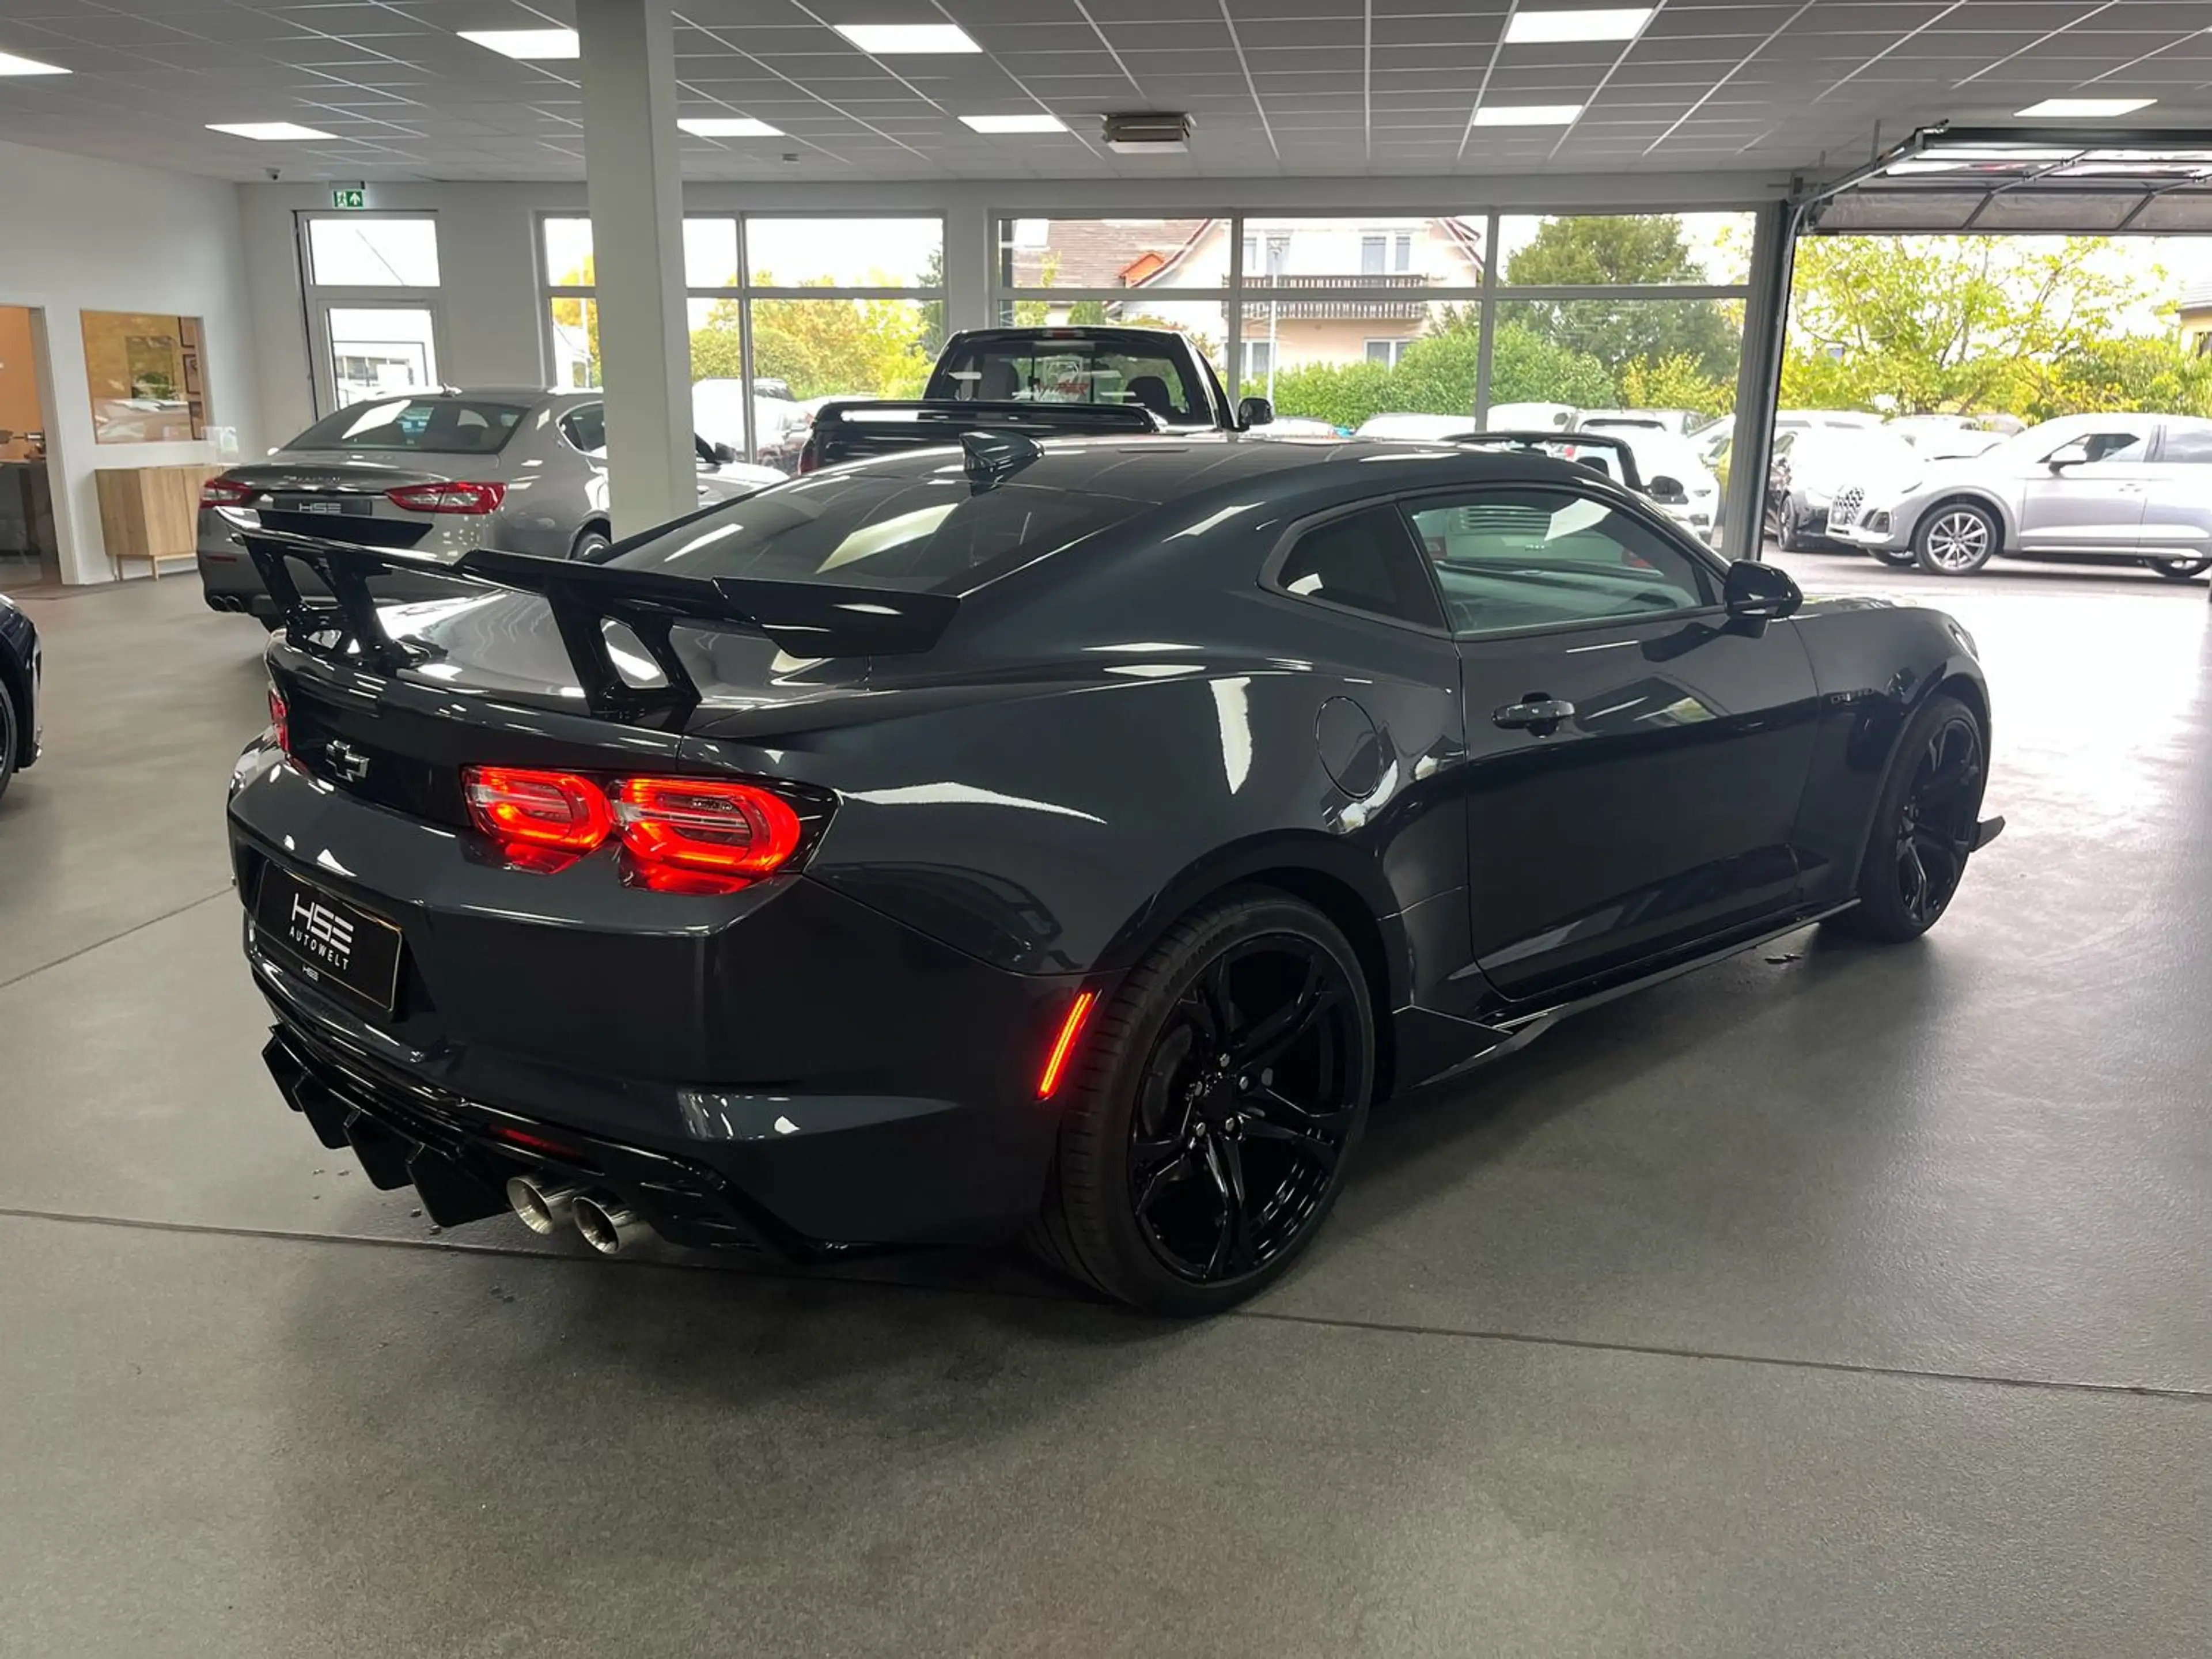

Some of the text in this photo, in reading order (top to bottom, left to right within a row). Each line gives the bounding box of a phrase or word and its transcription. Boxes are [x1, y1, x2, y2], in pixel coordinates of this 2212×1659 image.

[299, 502, 342, 514] HSE
[291, 893, 354, 955] HSE
[289, 926, 349, 970] AUTOWELT
